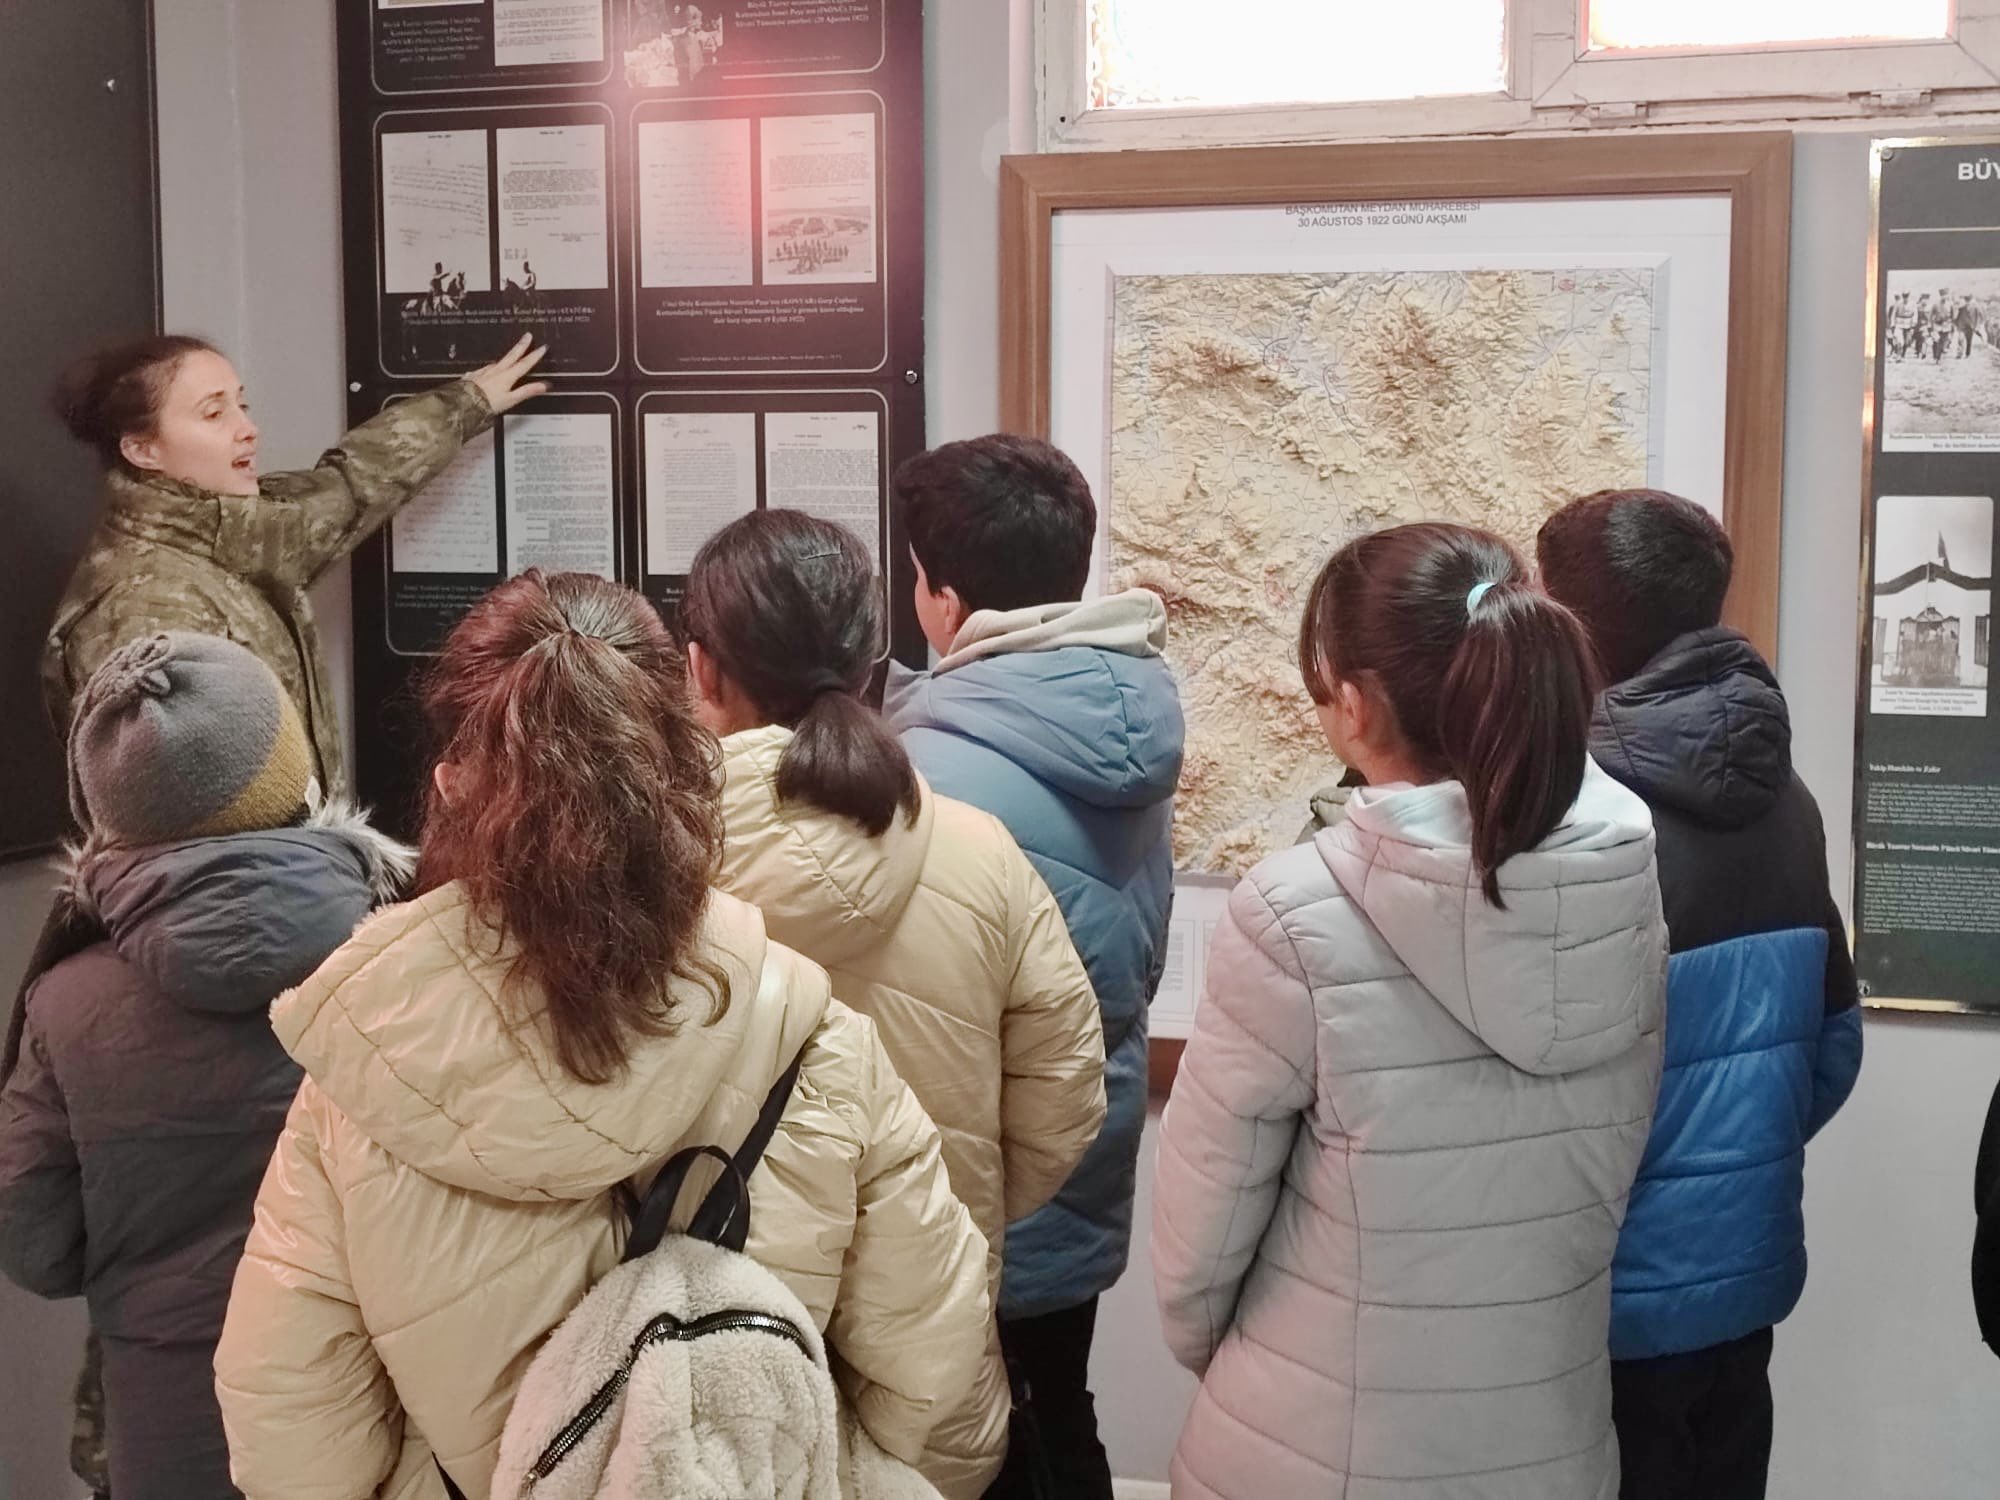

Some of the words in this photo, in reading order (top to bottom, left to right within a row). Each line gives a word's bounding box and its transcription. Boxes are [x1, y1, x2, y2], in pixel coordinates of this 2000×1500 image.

[1286, 203, 1358, 216] BAŞKOMUTAN
[1361, 201, 1405, 213] MEYDAN
[1298, 217, 1309, 228] 30
[1312, 215, 1363, 227] AĞUSTOS
[1367, 214, 1390, 226] 1922
[1392, 212, 1424, 225] GÜNÜ
[1426, 213, 1467, 227] AKŞAMI
